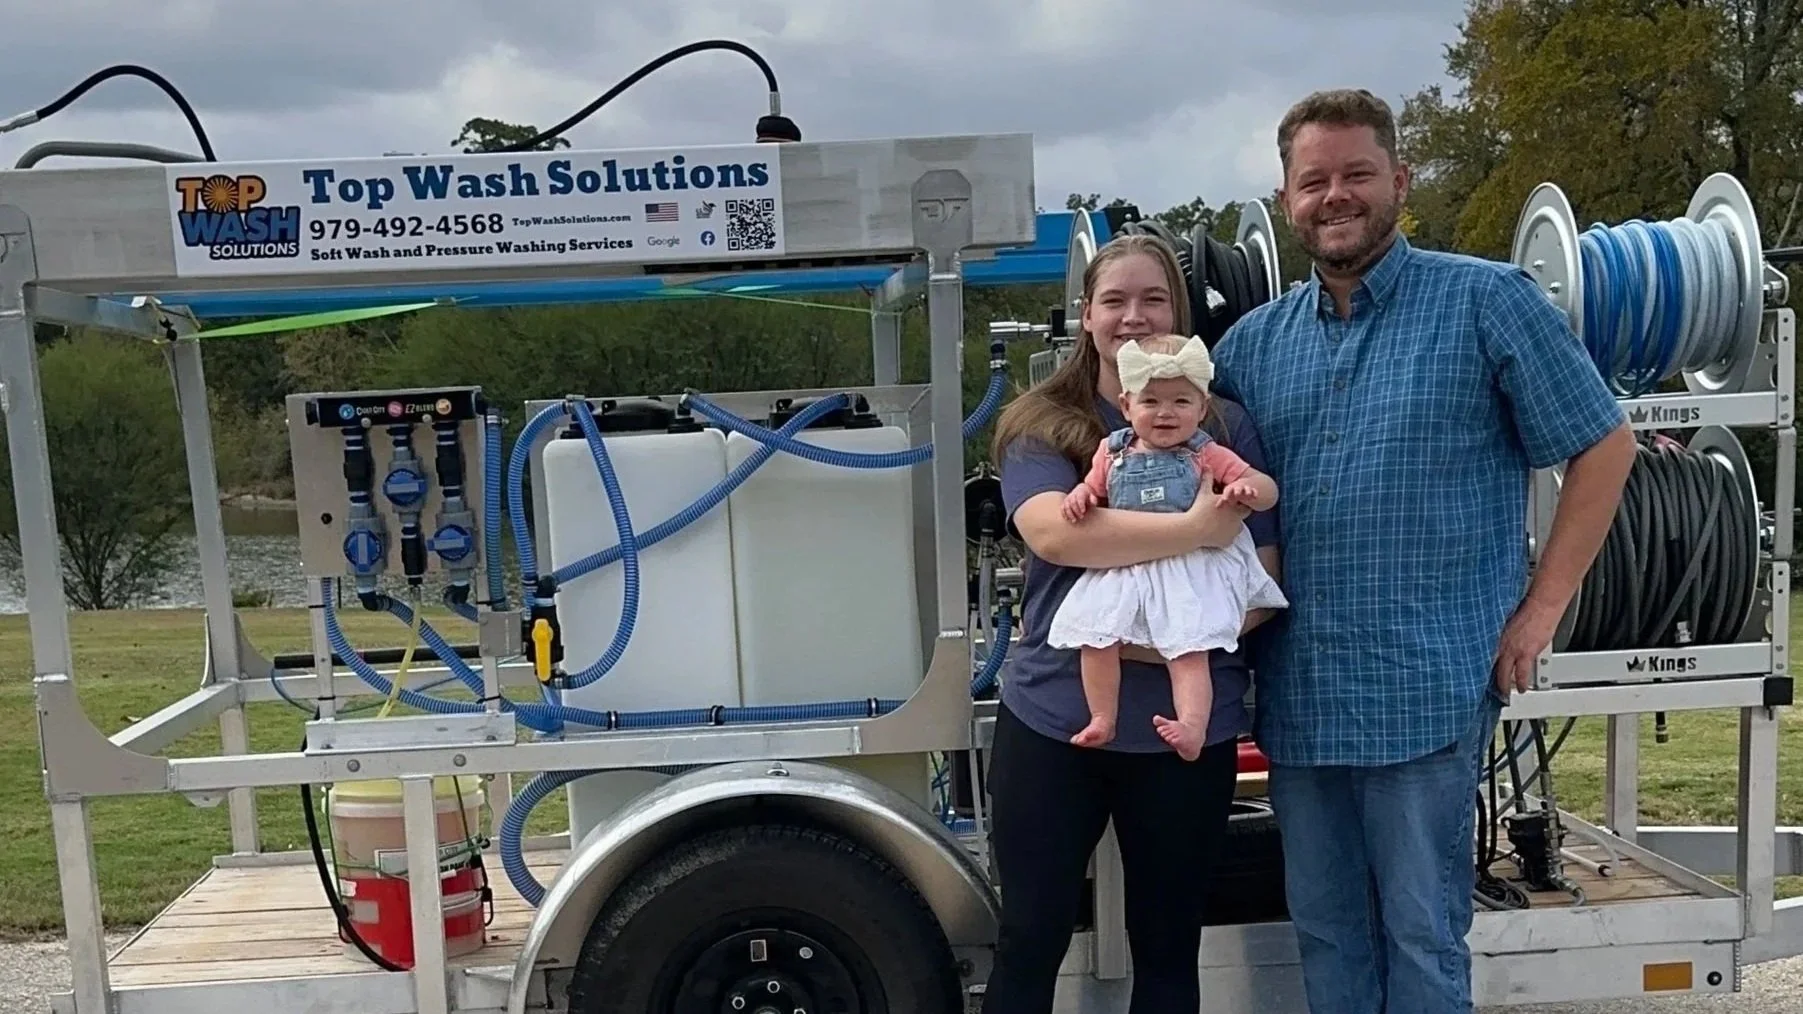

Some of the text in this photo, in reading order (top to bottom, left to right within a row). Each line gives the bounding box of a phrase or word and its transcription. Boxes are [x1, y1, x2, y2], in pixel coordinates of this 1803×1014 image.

[303, 155, 769, 210] Top Wash Solutions
[176, 175, 266, 213] TOP
[180, 206, 300, 246] WASH
[308, 213, 504, 240] 979-492-4568
[512, 214, 632, 226] TopWashSolutions.com
[212, 242, 298, 258] SOLUTIONS
[311, 237, 633, 261] Soft Wash and Pressure Washing Services
[647, 235, 680, 248] Google
[1651, 406, 1700, 422] Kings
[1648, 656, 1697, 672] Kings
